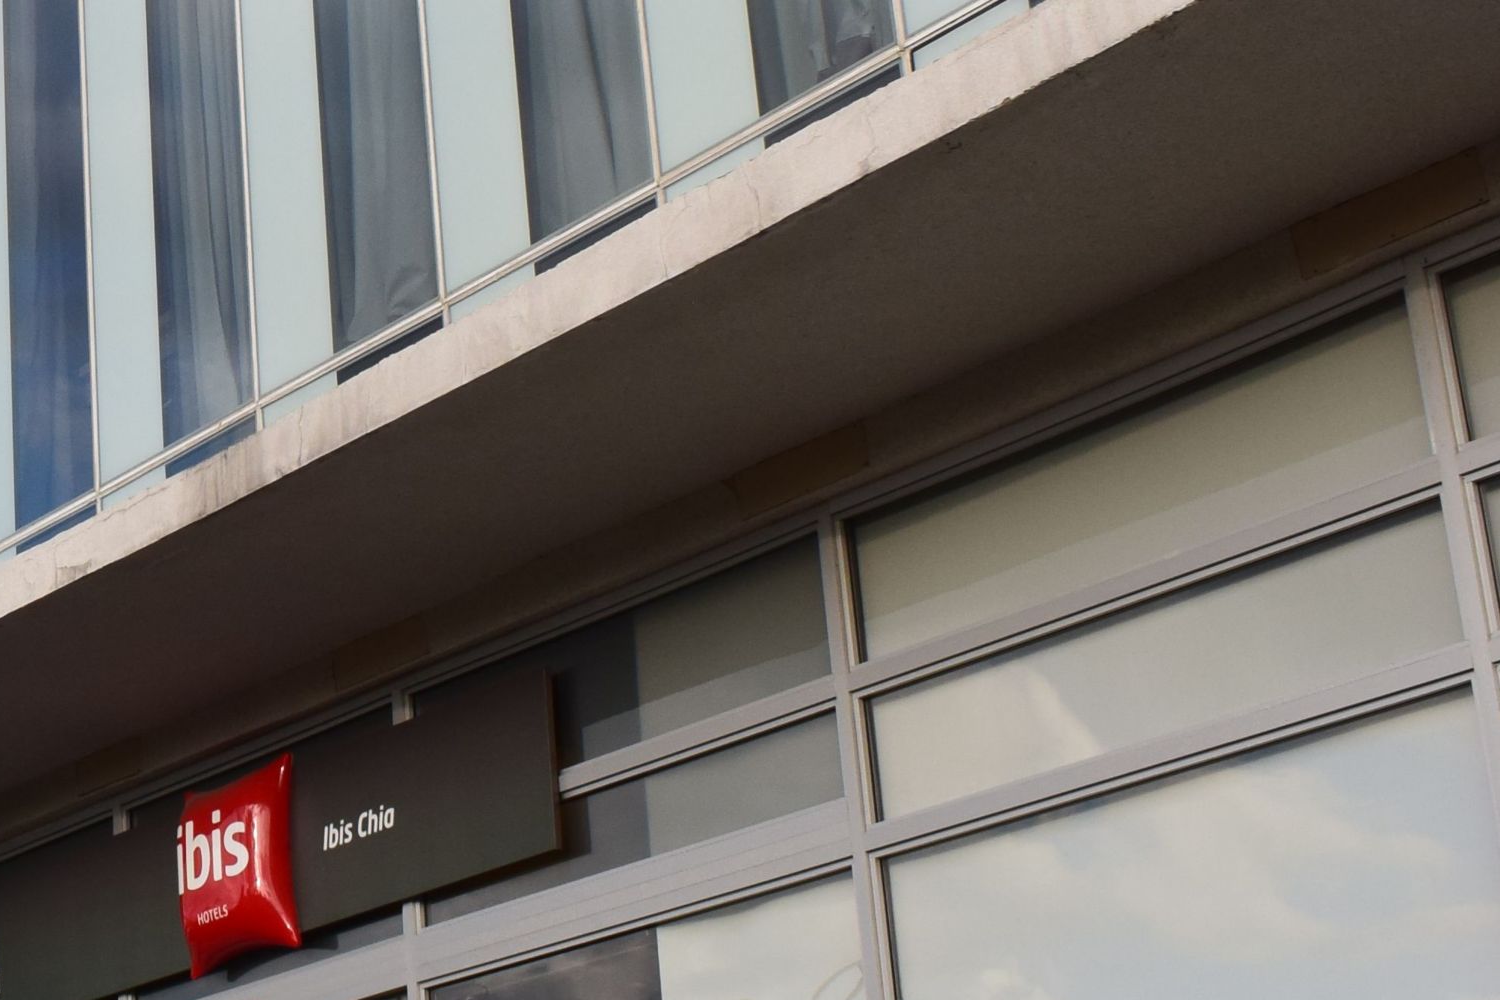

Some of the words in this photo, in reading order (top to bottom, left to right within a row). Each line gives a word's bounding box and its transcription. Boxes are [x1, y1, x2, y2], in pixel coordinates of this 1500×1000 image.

[323, 819, 353, 851] Ibis
[357, 804, 395, 838] Chia
[177, 809, 250, 895] ibis
[197, 904, 229, 926] HOTELS
